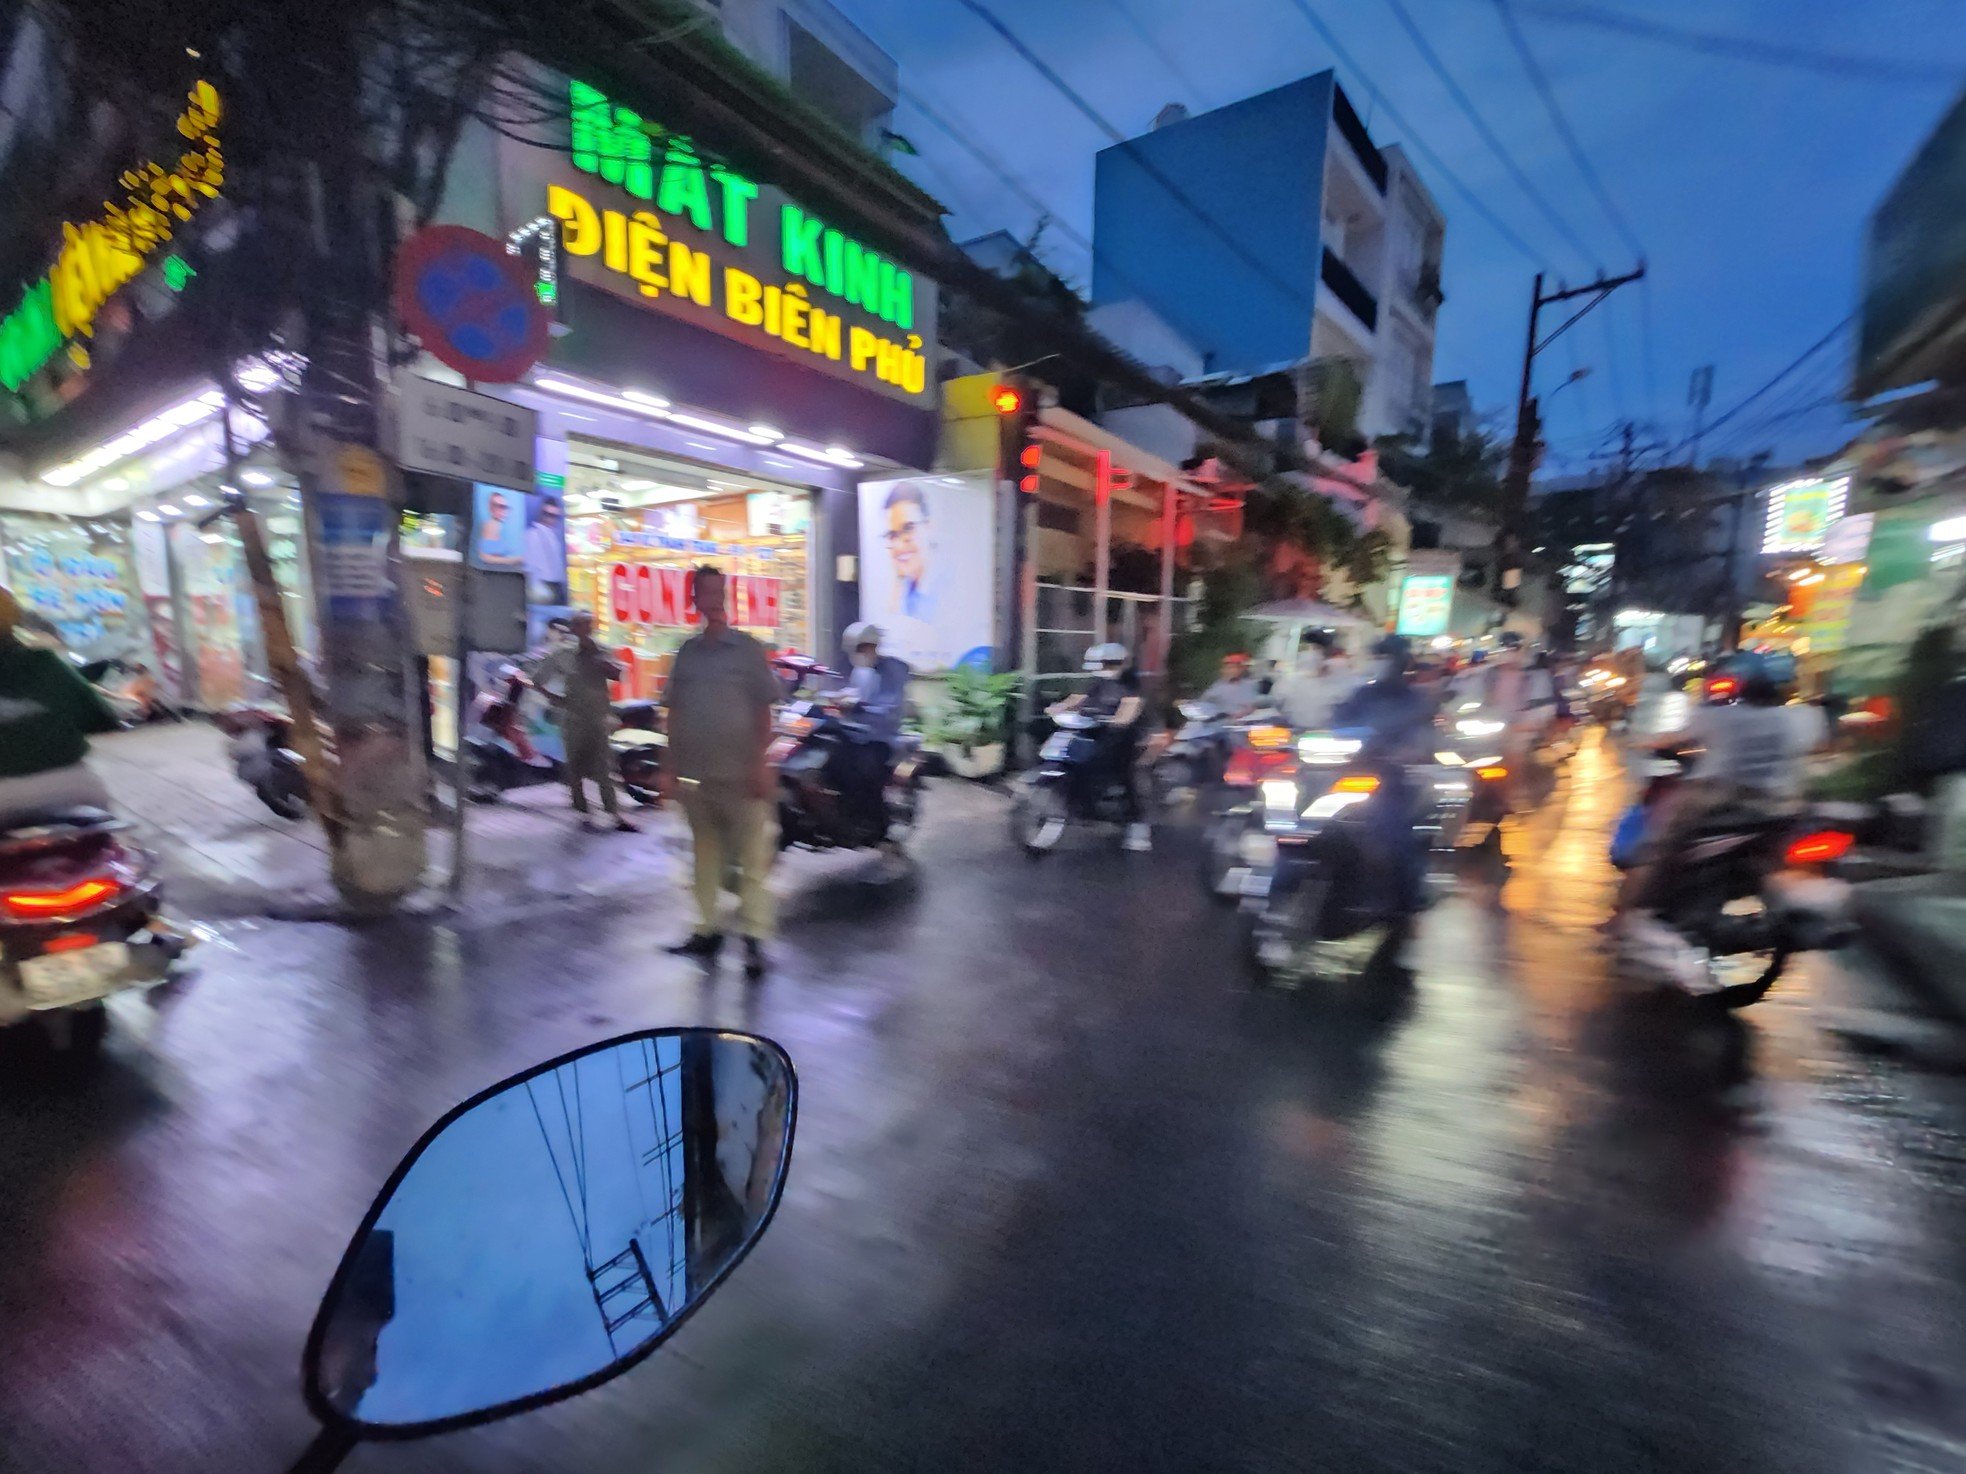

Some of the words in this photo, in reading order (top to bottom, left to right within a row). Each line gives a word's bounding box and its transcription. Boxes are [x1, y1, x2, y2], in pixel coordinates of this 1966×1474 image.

[548, 184, 712, 307] ĐIỆN
[724, 267, 842, 361] BIÊN
[850, 326, 926, 395] PHỦ
